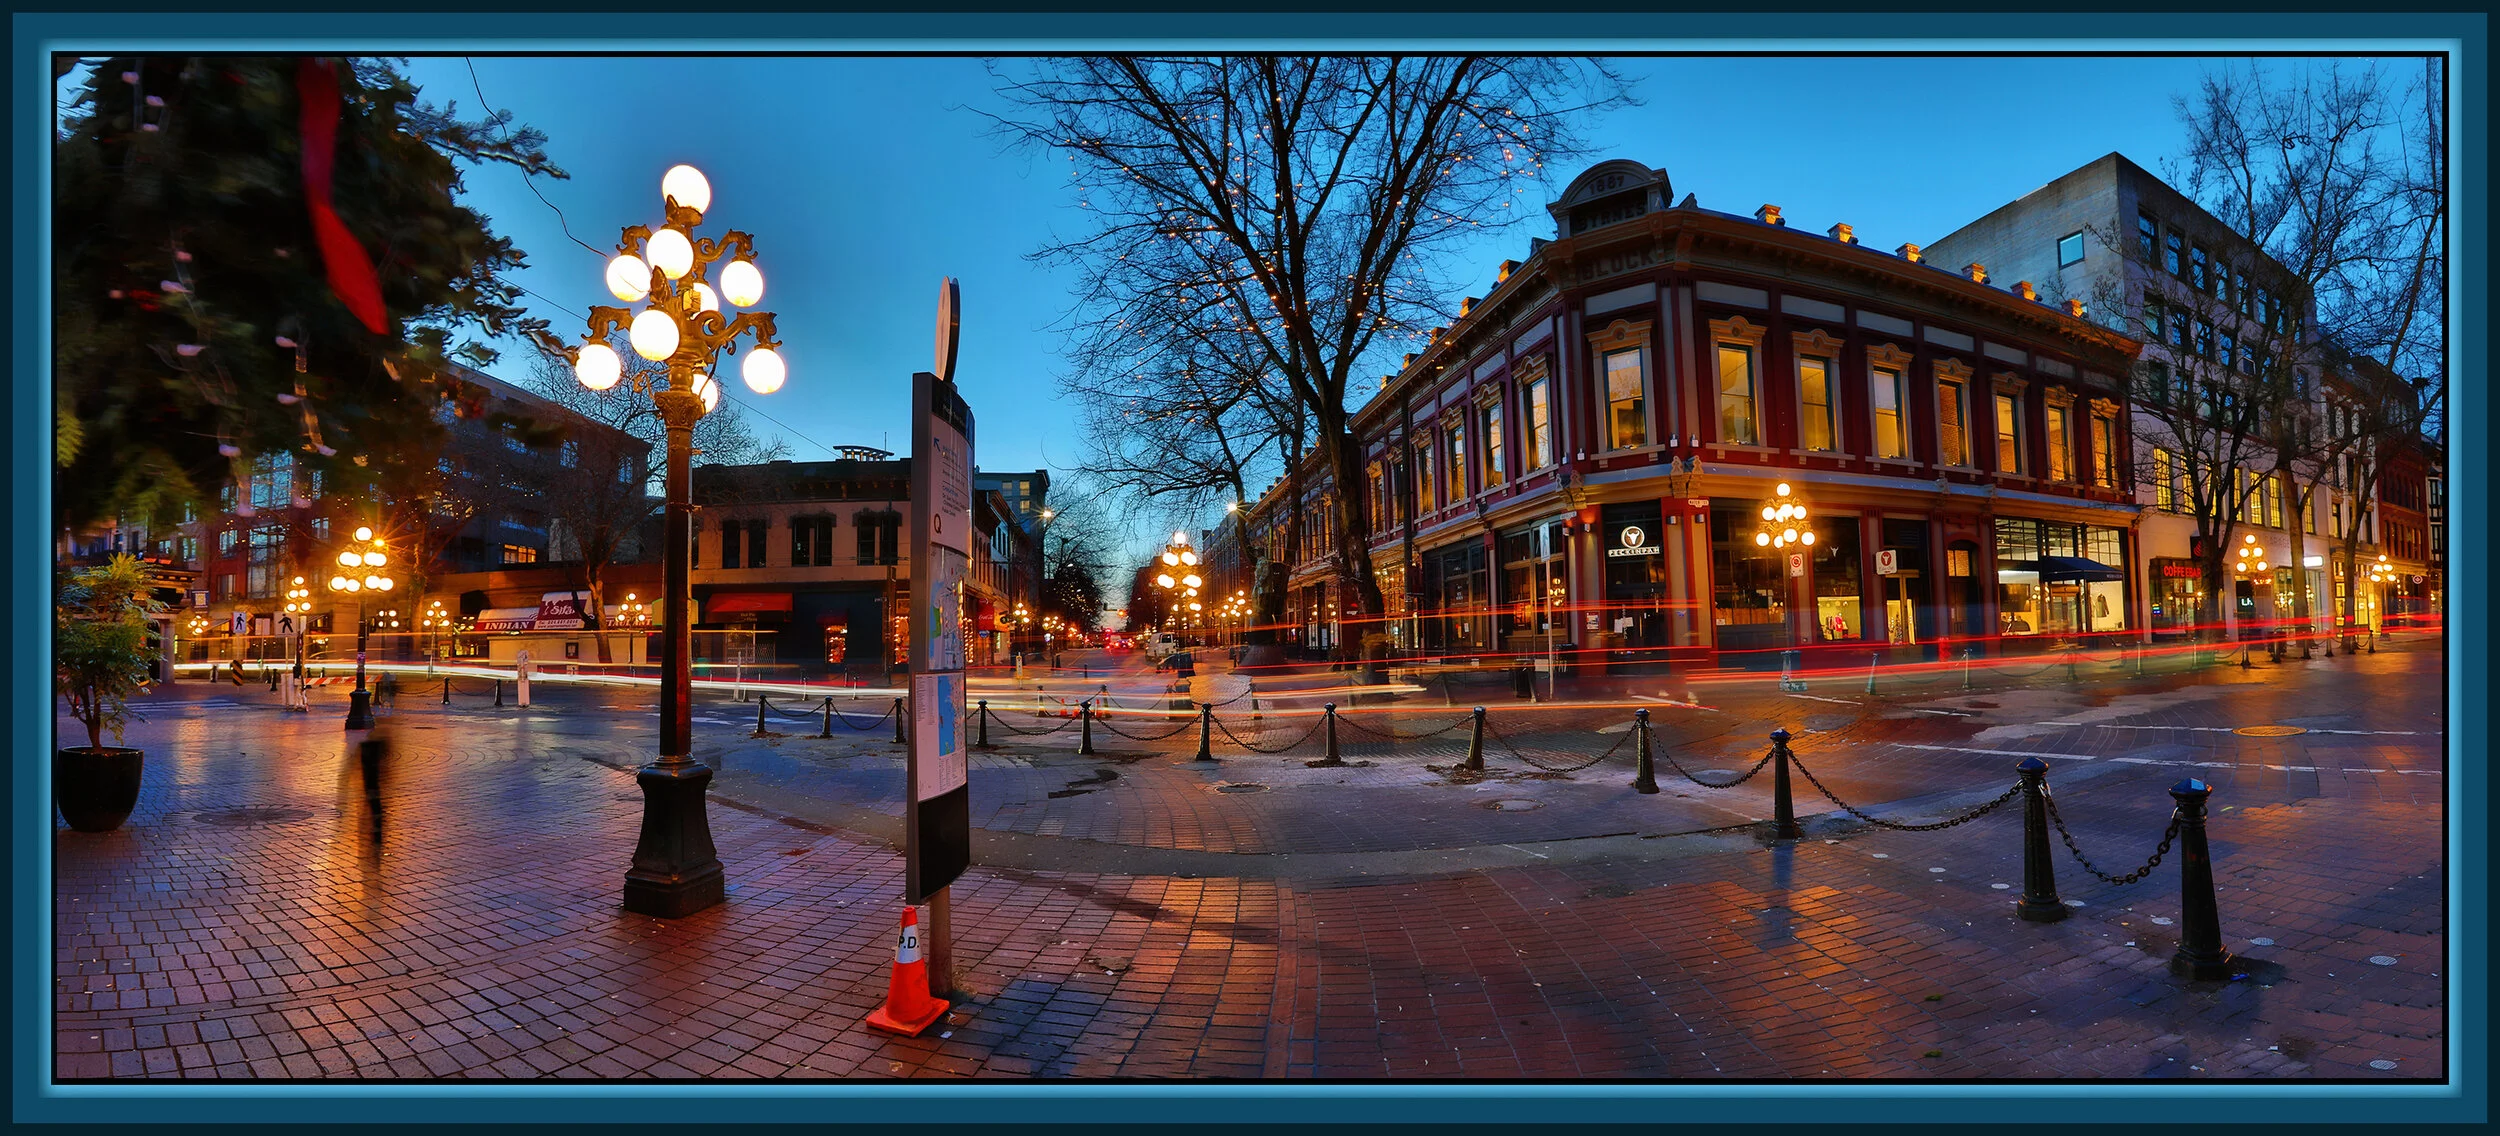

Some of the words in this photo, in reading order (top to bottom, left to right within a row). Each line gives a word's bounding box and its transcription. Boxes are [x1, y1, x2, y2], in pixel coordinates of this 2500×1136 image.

[1589, 175, 1625, 196] 1887
[1576, 200, 1646, 231] BYRNES
[1582, 246, 1655, 281] BLOCK
[933, 513, 942, 535] Q
[484, 621, 530, 630] INDIAN
[898, 936, 920, 949] P.D.
